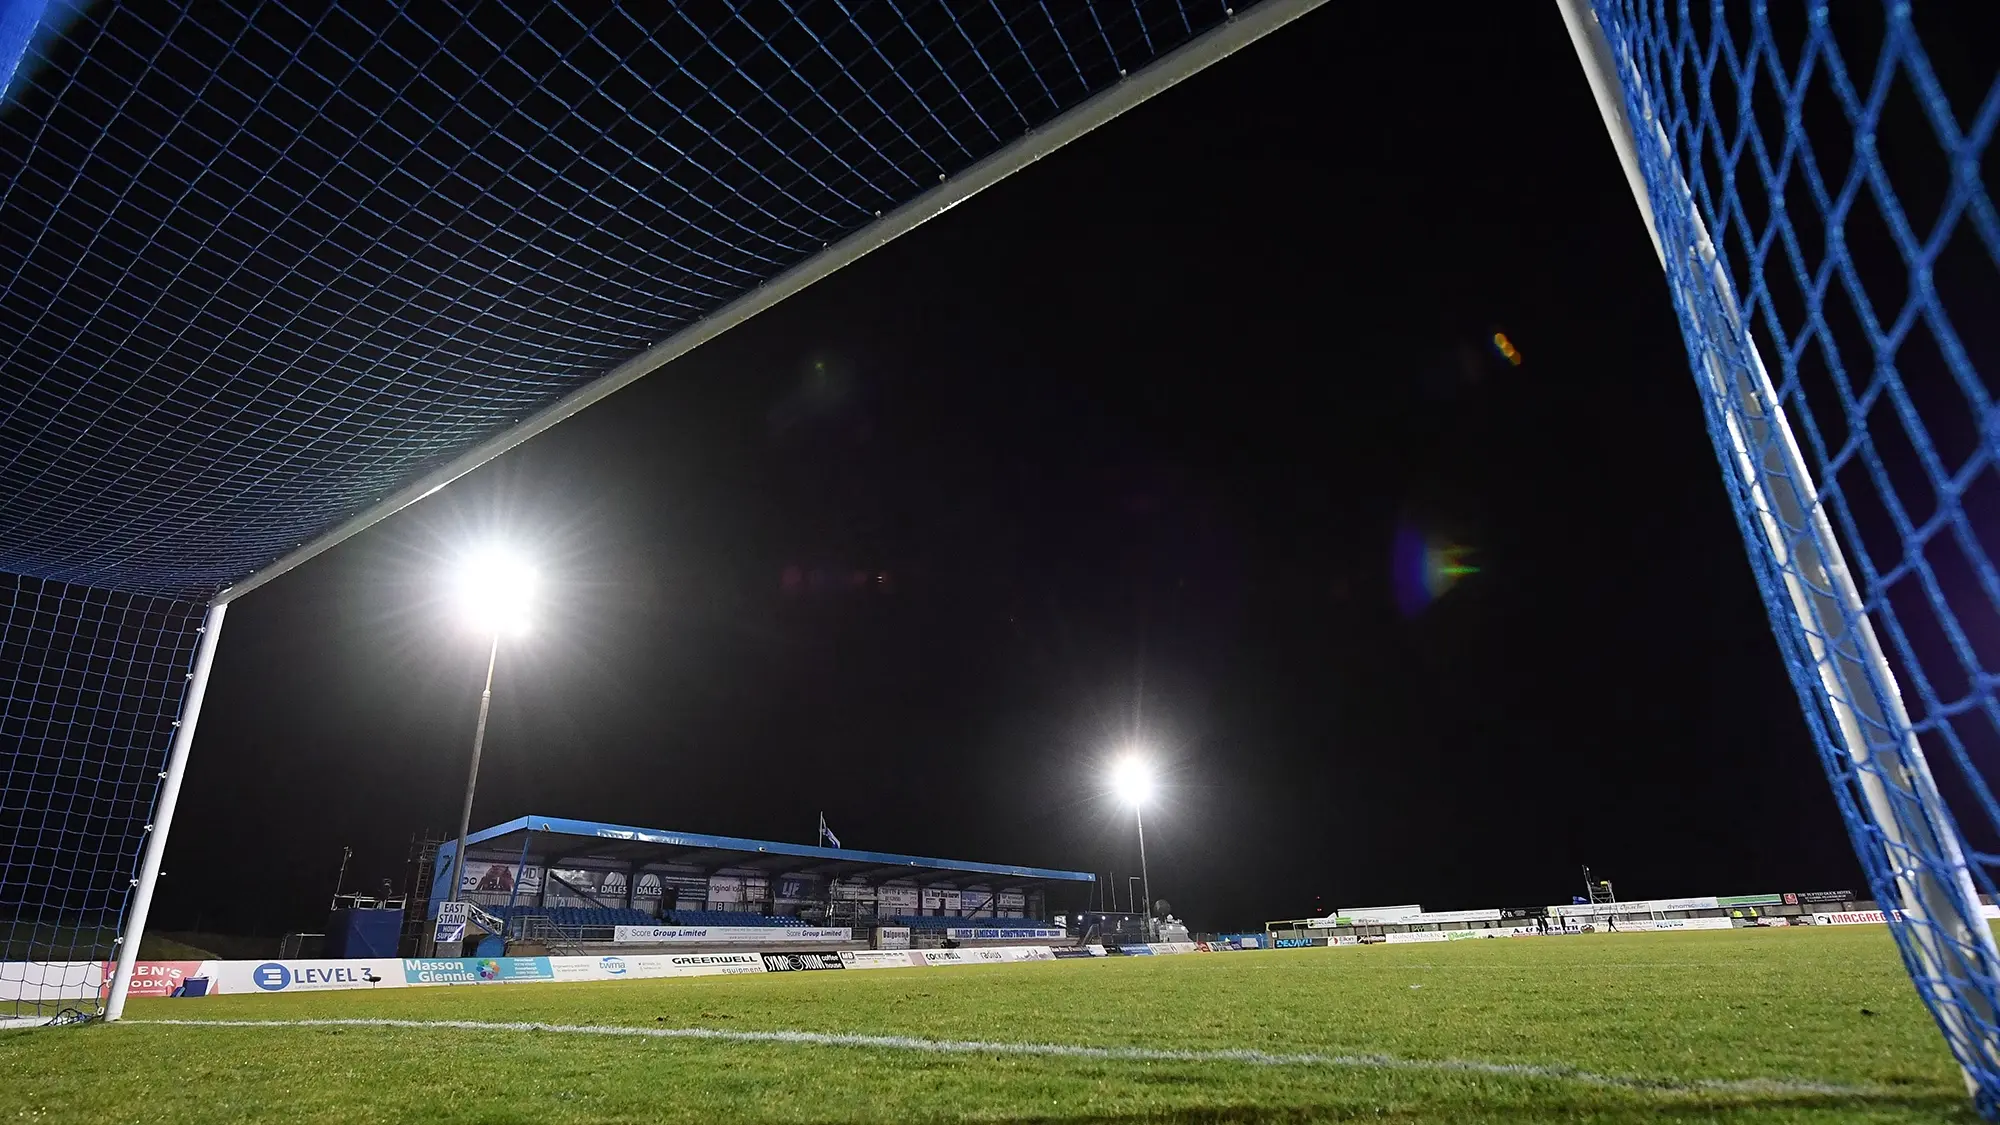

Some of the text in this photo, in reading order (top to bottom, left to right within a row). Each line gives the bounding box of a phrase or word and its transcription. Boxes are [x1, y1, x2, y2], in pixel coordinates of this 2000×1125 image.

[601, 885, 627, 894] DALES
[637, 886, 662, 895] DALES
[444, 903, 464, 913] EAST
[717, 902, 723, 910] B
[438, 914, 465, 923] STAND
[631, 929, 706, 938] Score Group Limited
[786, 929, 800, 937] Score
[672, 955, 758, 964] GREENWELL
[405, 959, 464, 971] Masson
[599, 961, 626, 969] twma
[722, 966, 763, 975] equipment
[294, 968, 358, 983] LEVEL
[418, 970, 475, 982] Glennie
[131, 980, 175, 988] ODKA
